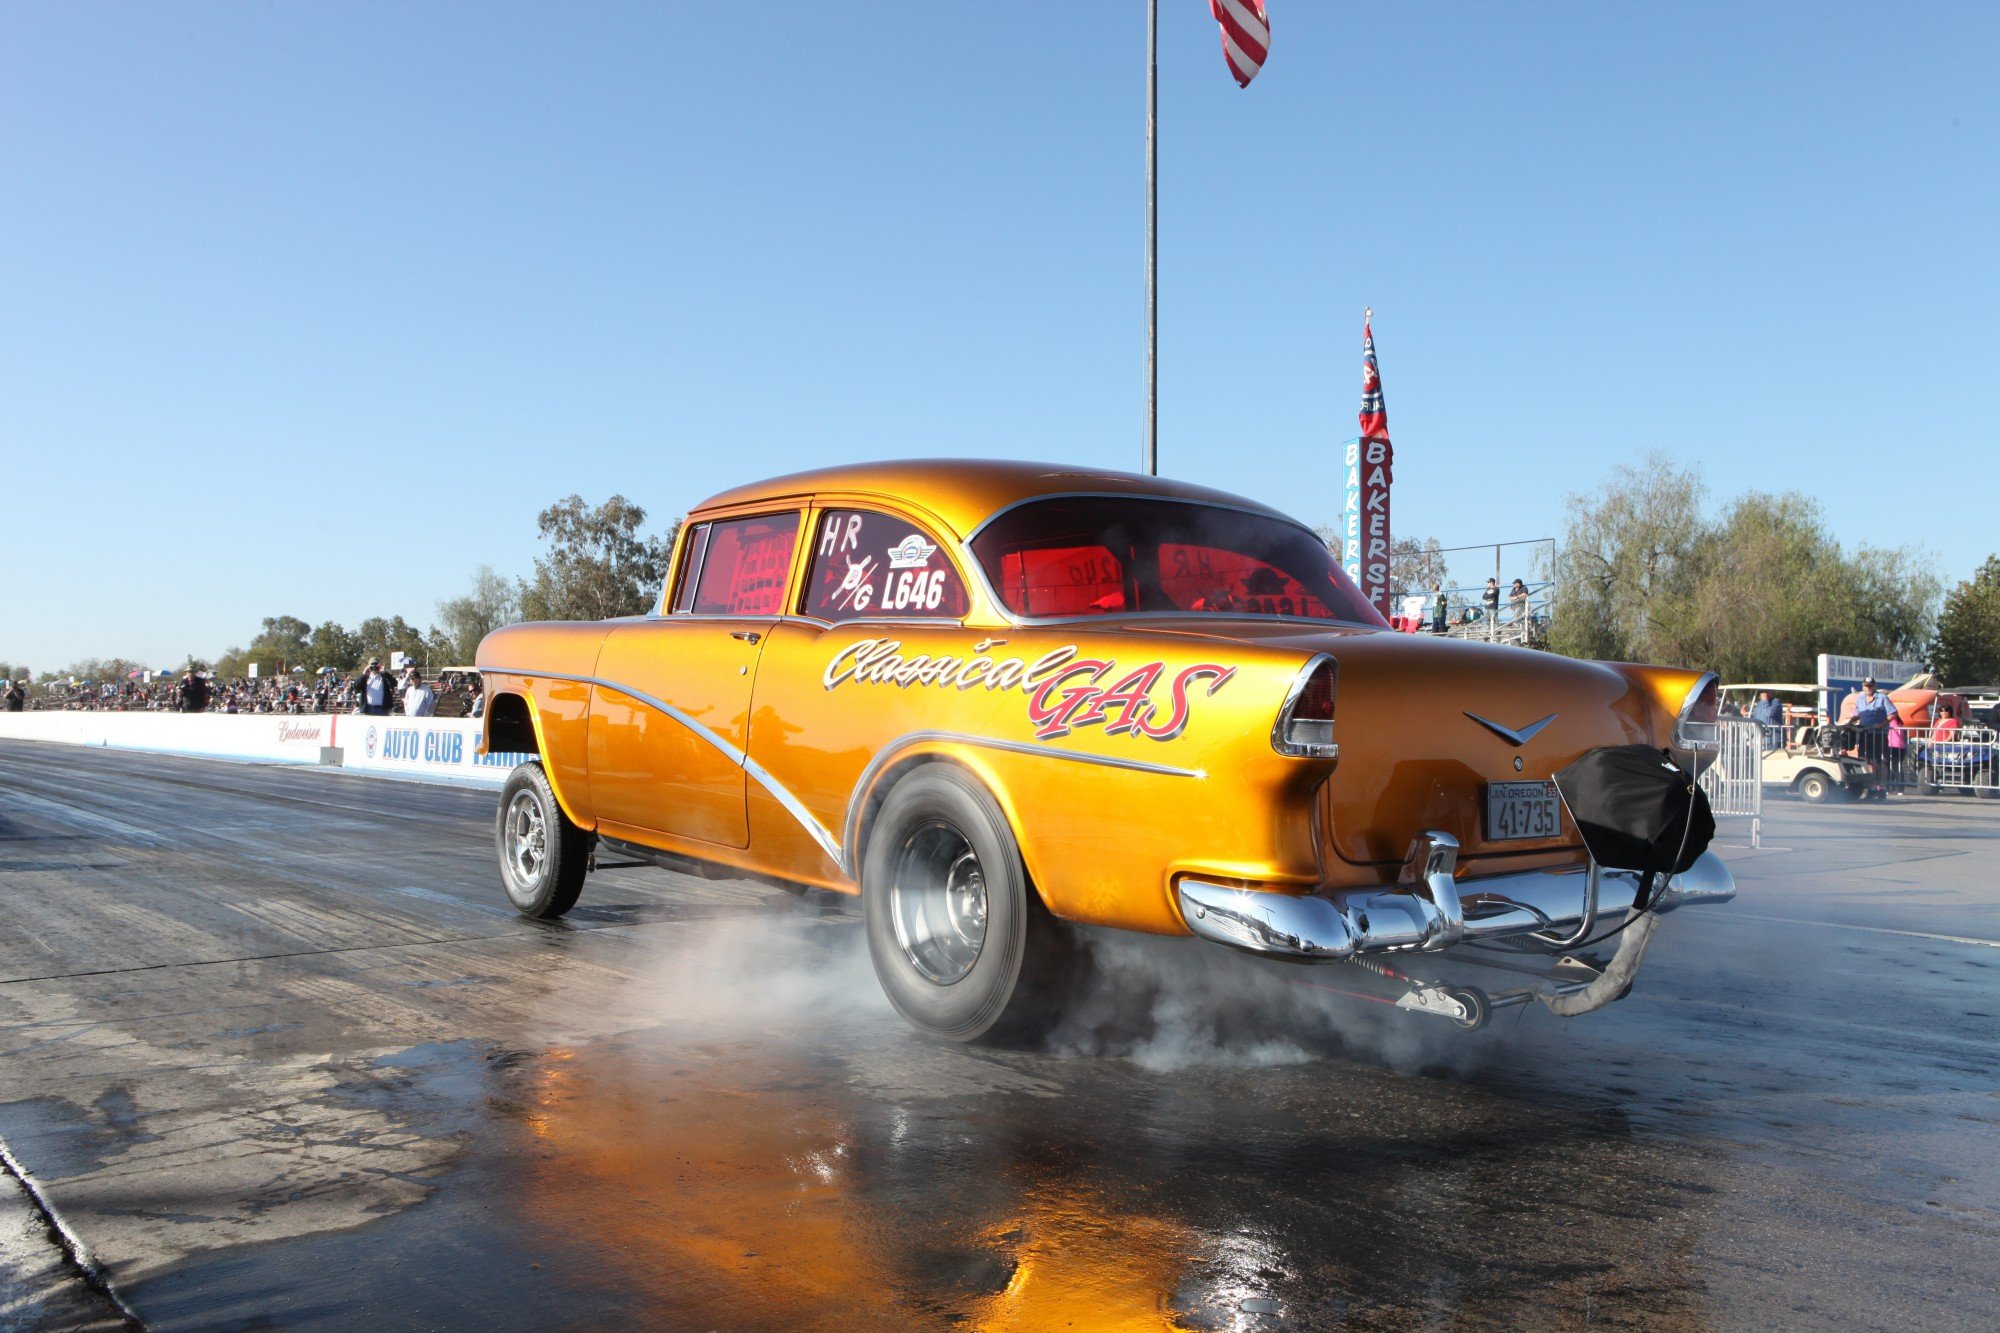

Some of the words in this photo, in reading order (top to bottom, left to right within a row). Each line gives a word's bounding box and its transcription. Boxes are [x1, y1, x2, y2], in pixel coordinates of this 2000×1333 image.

[881, 570, 945, 610] L646
[823, 638, 1078, 693] Classical
[1028, 659, 1238, 741] GAS
[279, 720, 320, 742] Budweiser
[383, 729, 420, 761] AUTO
[424, 731, 463, 764] CLUB
[1509, 788, 1543, 798] OREGON
